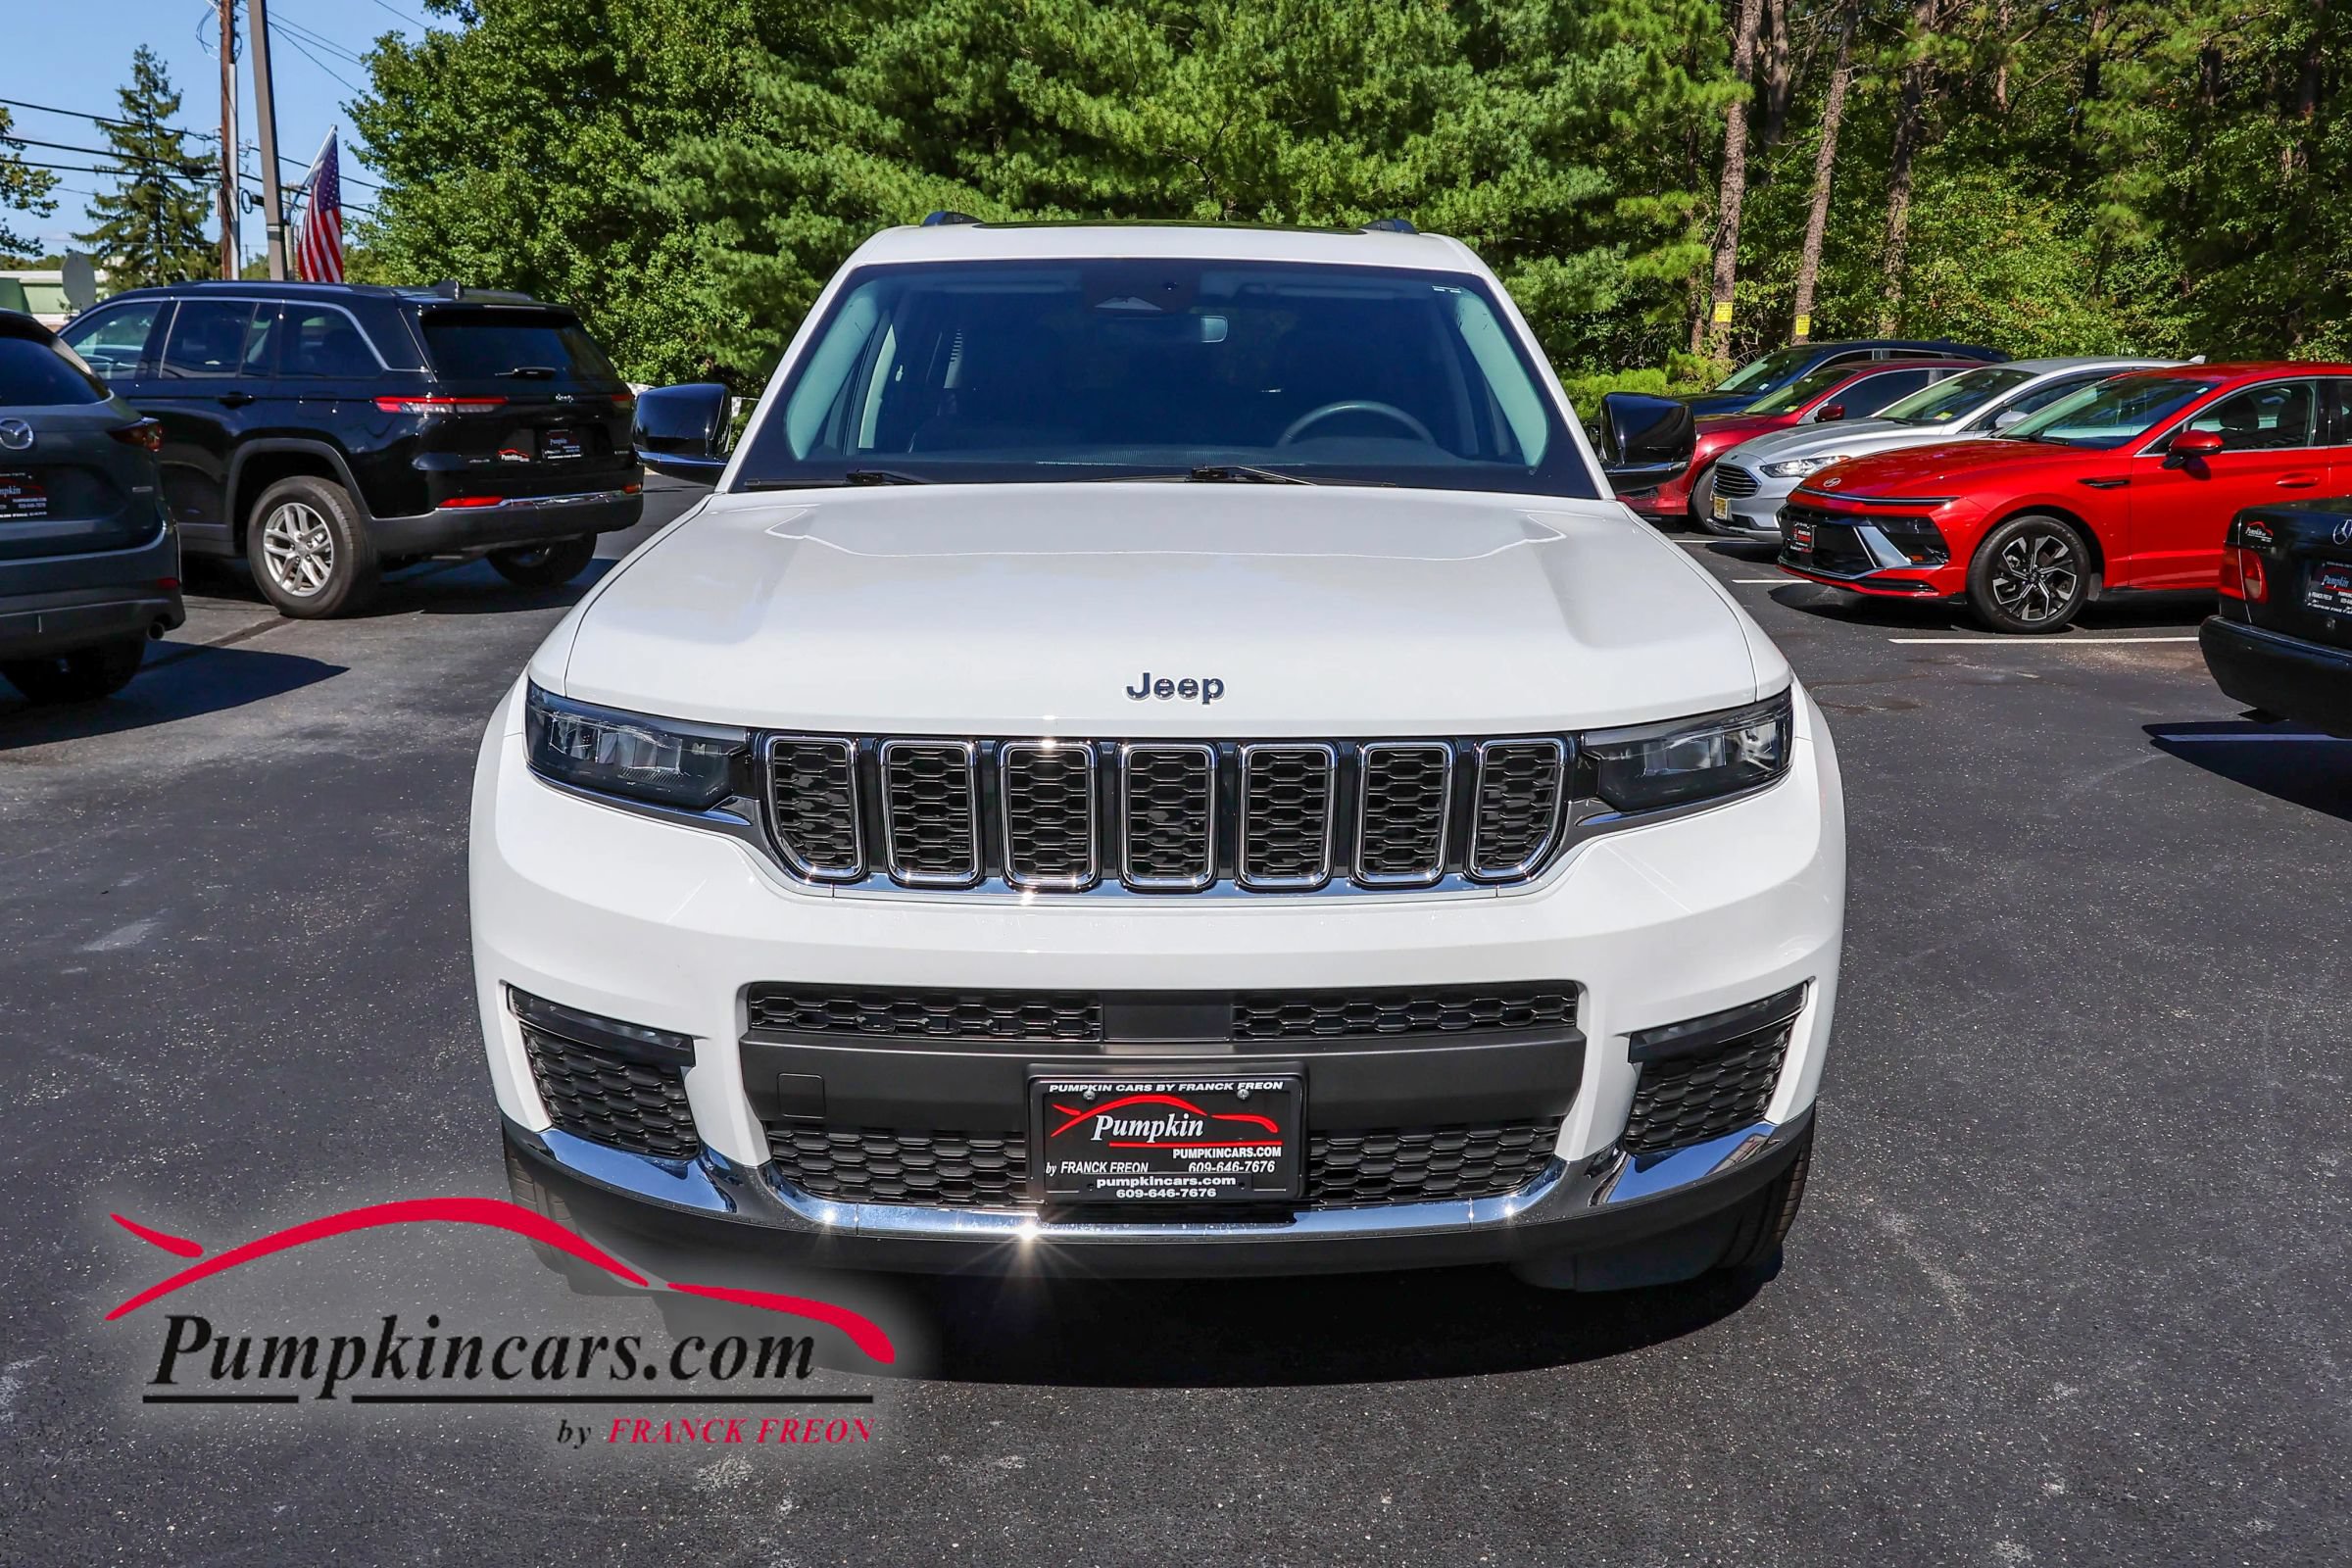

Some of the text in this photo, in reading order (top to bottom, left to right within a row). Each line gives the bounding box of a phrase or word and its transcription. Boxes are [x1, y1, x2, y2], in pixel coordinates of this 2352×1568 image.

[2321, 574, 2350, 589] Pumpkin
[1126, 669, 1225, 705] Jeep
[1178, 1083, 1234, 1092] FRANCK
[1090, 1112, 1203, 1143] Pumpkin
[1172, 1147, 1282, 1158] PUMPKINCARS.COM
[1045, 1161, 1149, 1177] by FRANCK FREON
[1188, 1160, 1276, 1173] 609-646-7676
[1096, 1176, 1237, 1188] pumpkincars.com
[1116, 1188, 1217, 1199] 609-646-7676
